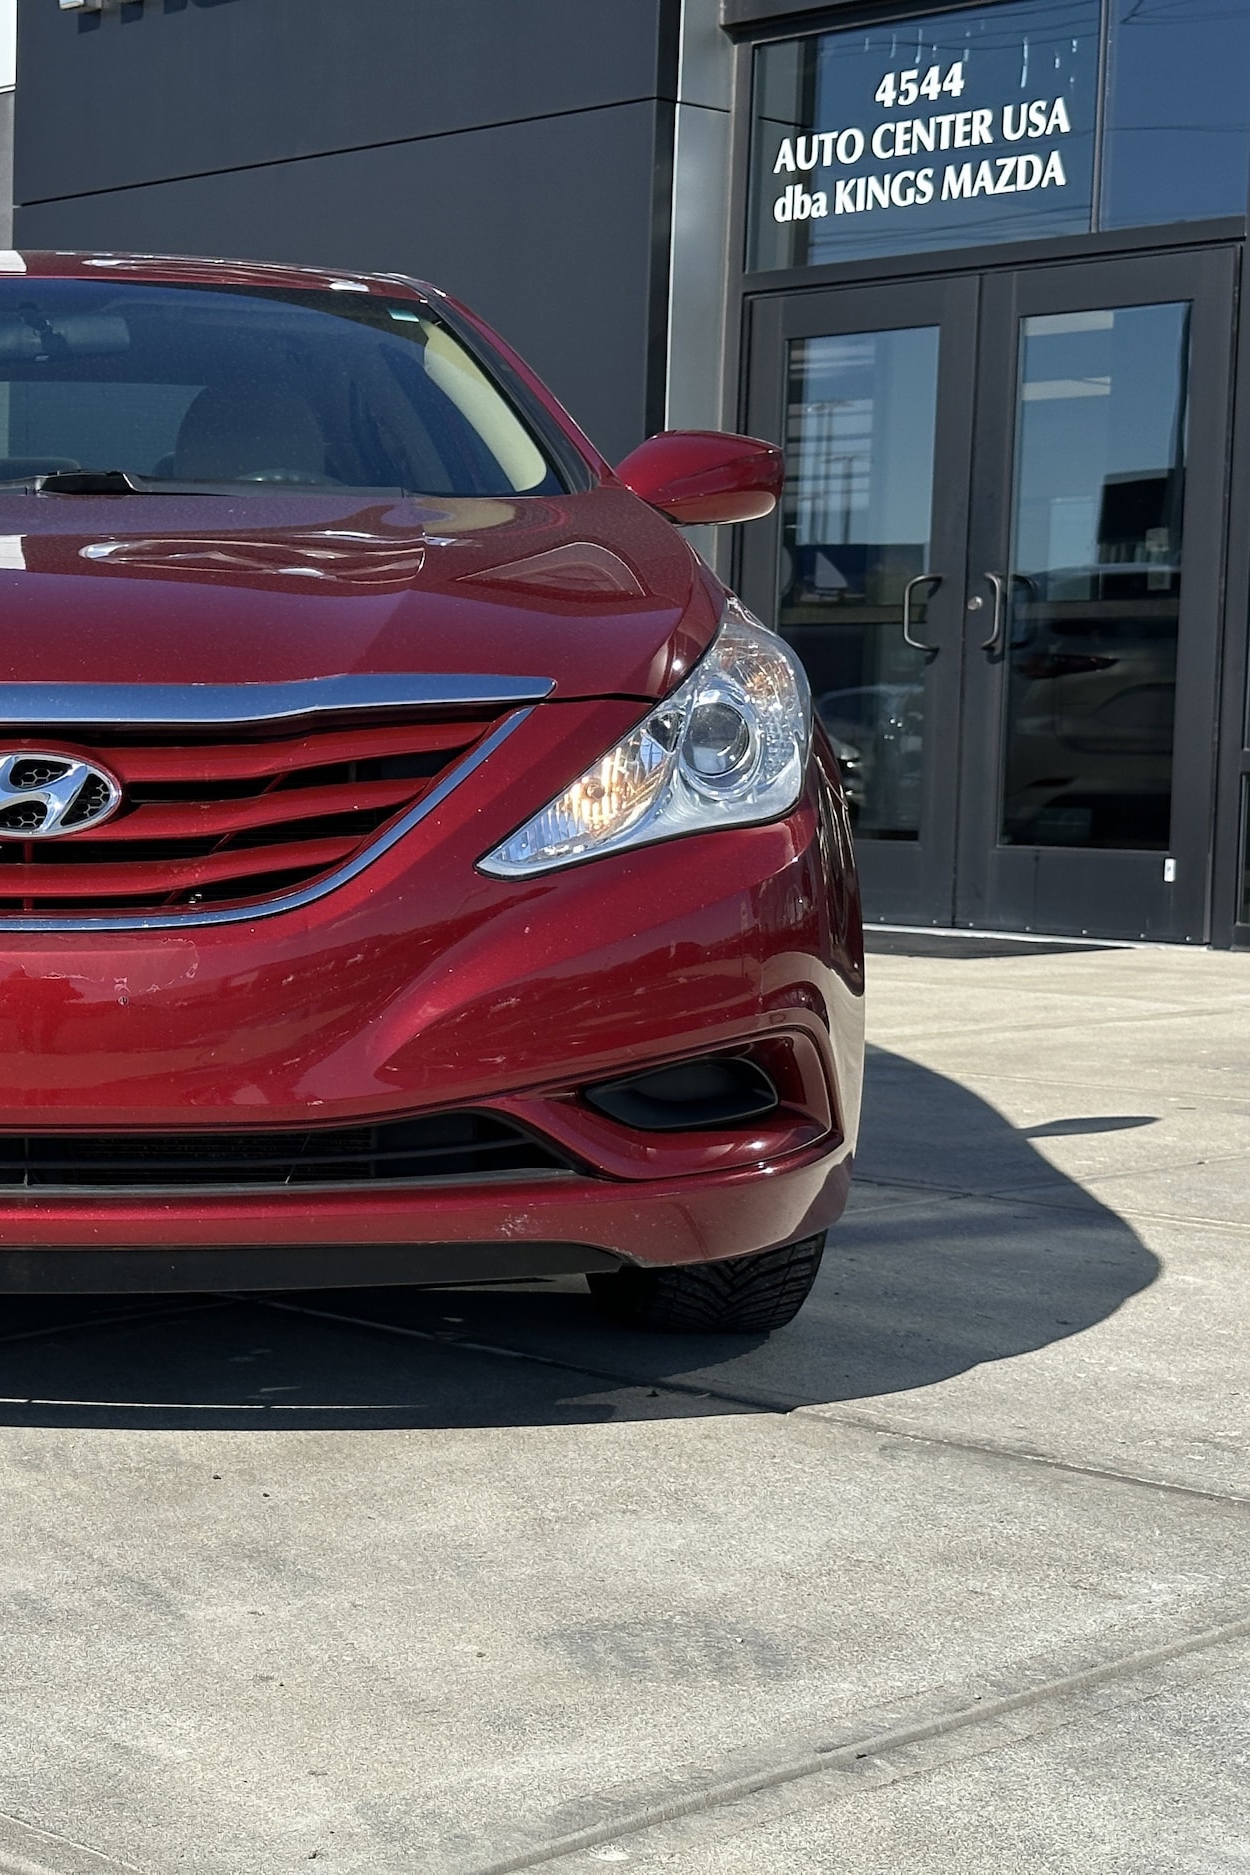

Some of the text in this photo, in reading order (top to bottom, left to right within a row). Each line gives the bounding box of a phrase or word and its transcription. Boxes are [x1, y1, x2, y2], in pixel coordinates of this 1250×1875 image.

[874, 61, 965, 108] 4544
[773, 96, 1071, 174] AUTO CENTER USA
[773, 150, 1067, 223] dba KINGS MAZDA
